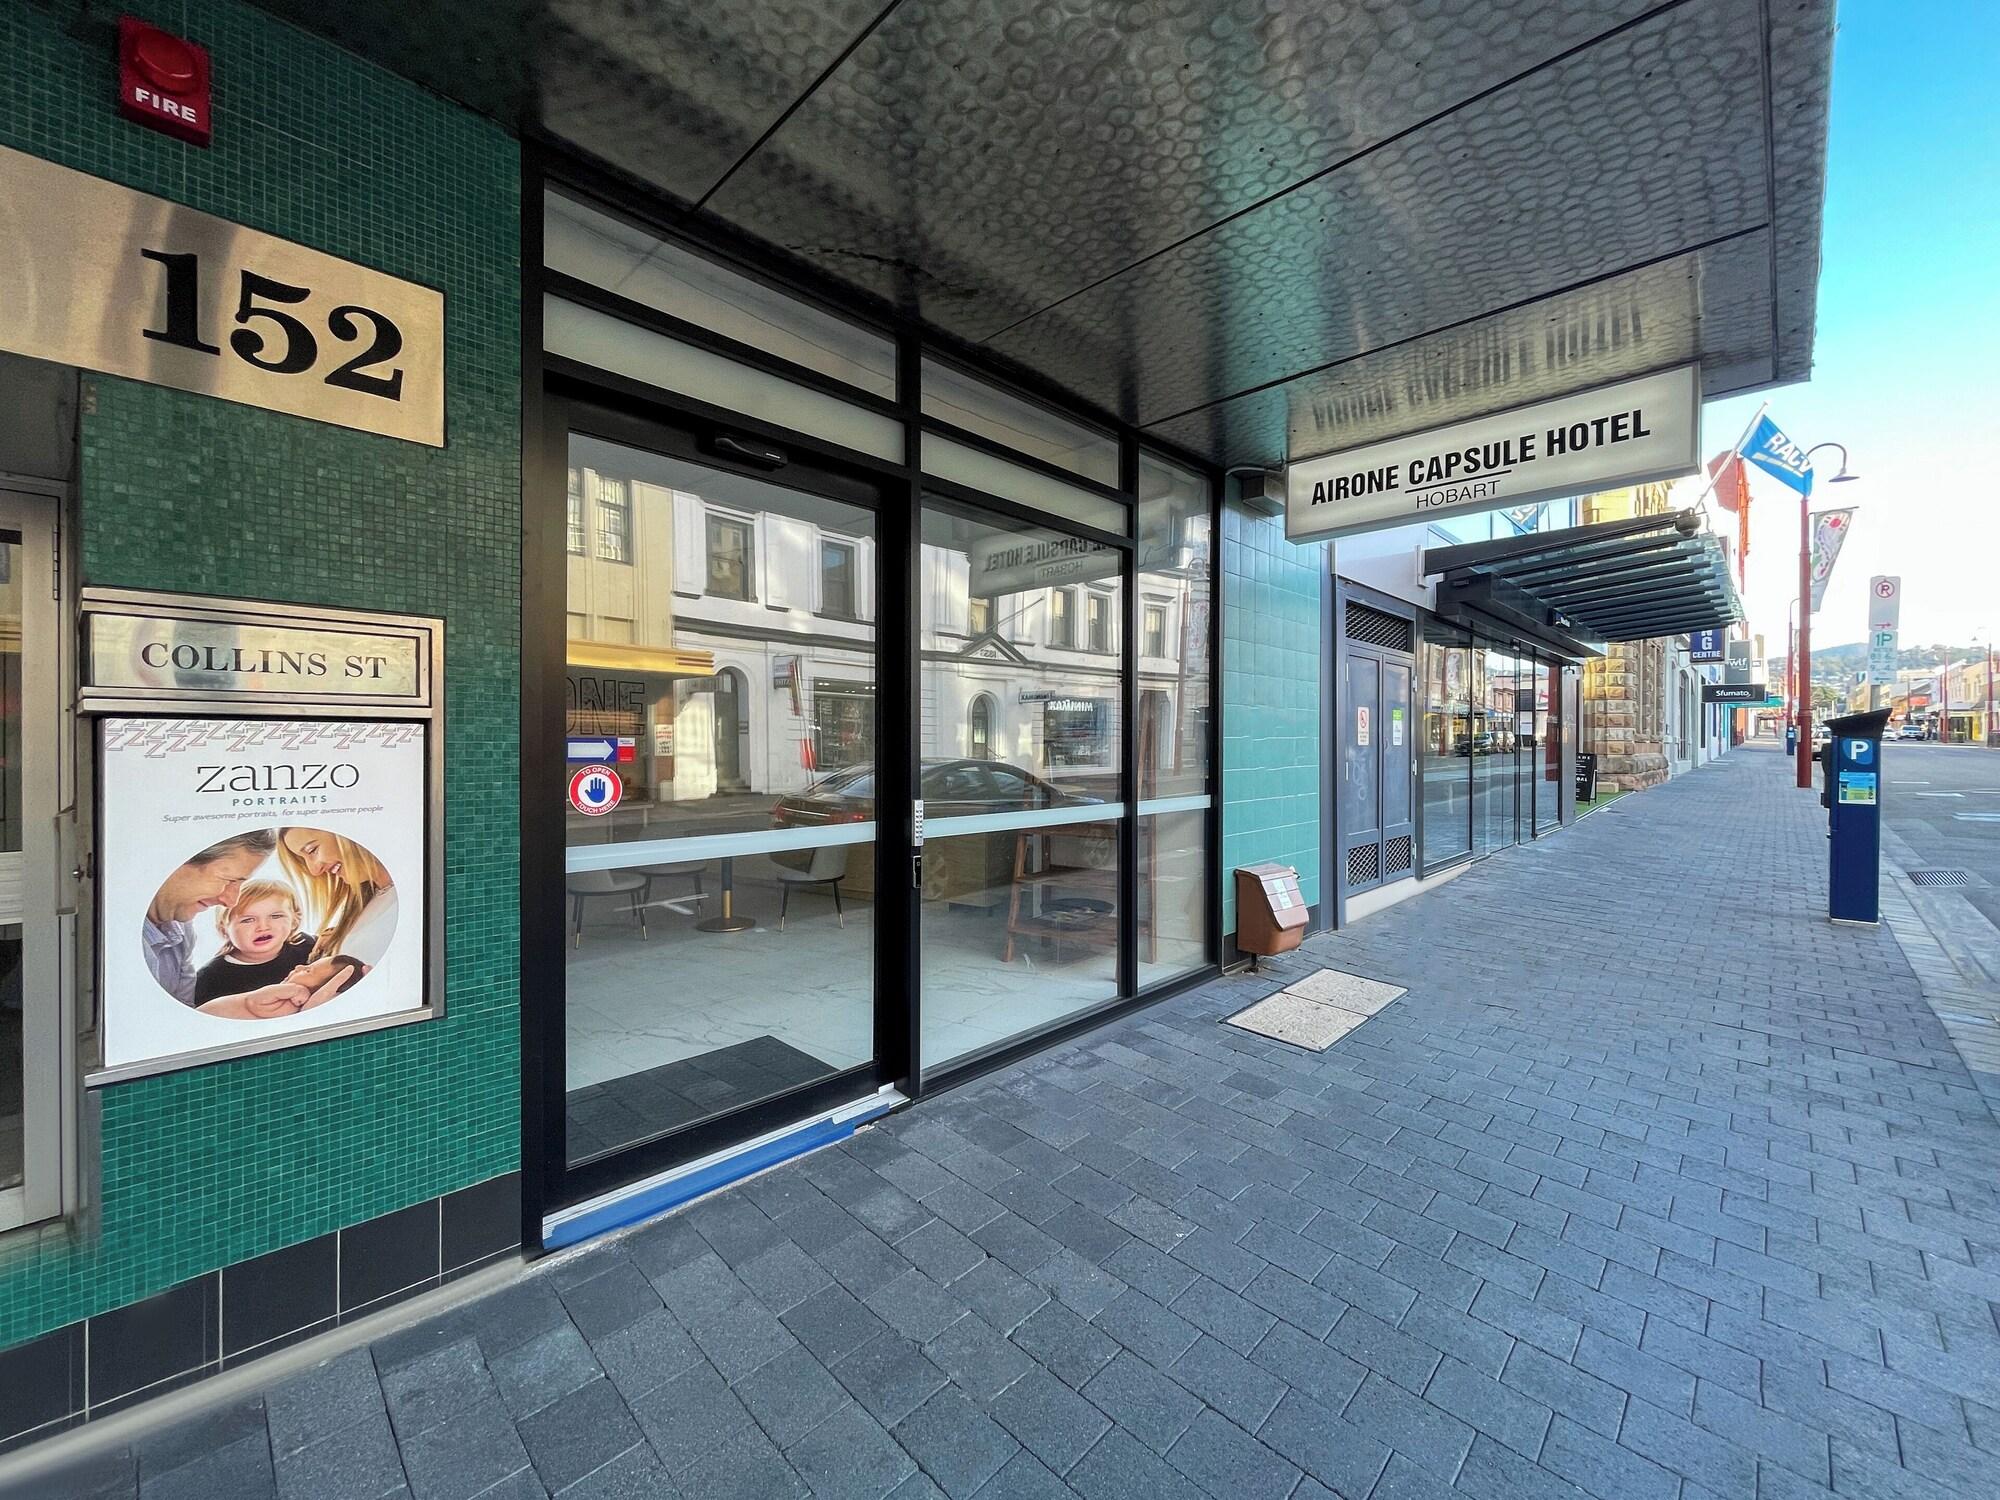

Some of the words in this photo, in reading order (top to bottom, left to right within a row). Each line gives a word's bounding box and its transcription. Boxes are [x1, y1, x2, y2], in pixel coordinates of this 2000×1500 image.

[135, 87, 197, 124] FIRE
[141, 248, 404, 402] 152
[1311, 465, 1399, 506] AIRONE
[1408, 433, 1536, 485] CAPSULE
[1546, 409, 1651, 457] HOTEL
[1416, 480, 1501, 509] HOBART
[141, 643, 327, 677] COLLINS
[344, 655, 387, 679] ST
[1692, 650, 1721, 659] CENTRE
[1851, 741, 1869, 760] P
[195, 763, 360, 793] zanzo
[592, 767, 611, 776] OPEN
[232, 795, 327, 807] PORTRAITS
[577, 801, 598, 813] TOUCH
[599, 800, 616, 812] HERE
[161, 814, 191, 823] Super
[282, 808, 295, 816] for
[296, 808, 319, 817] super
[357, 805, 384, 814] people
